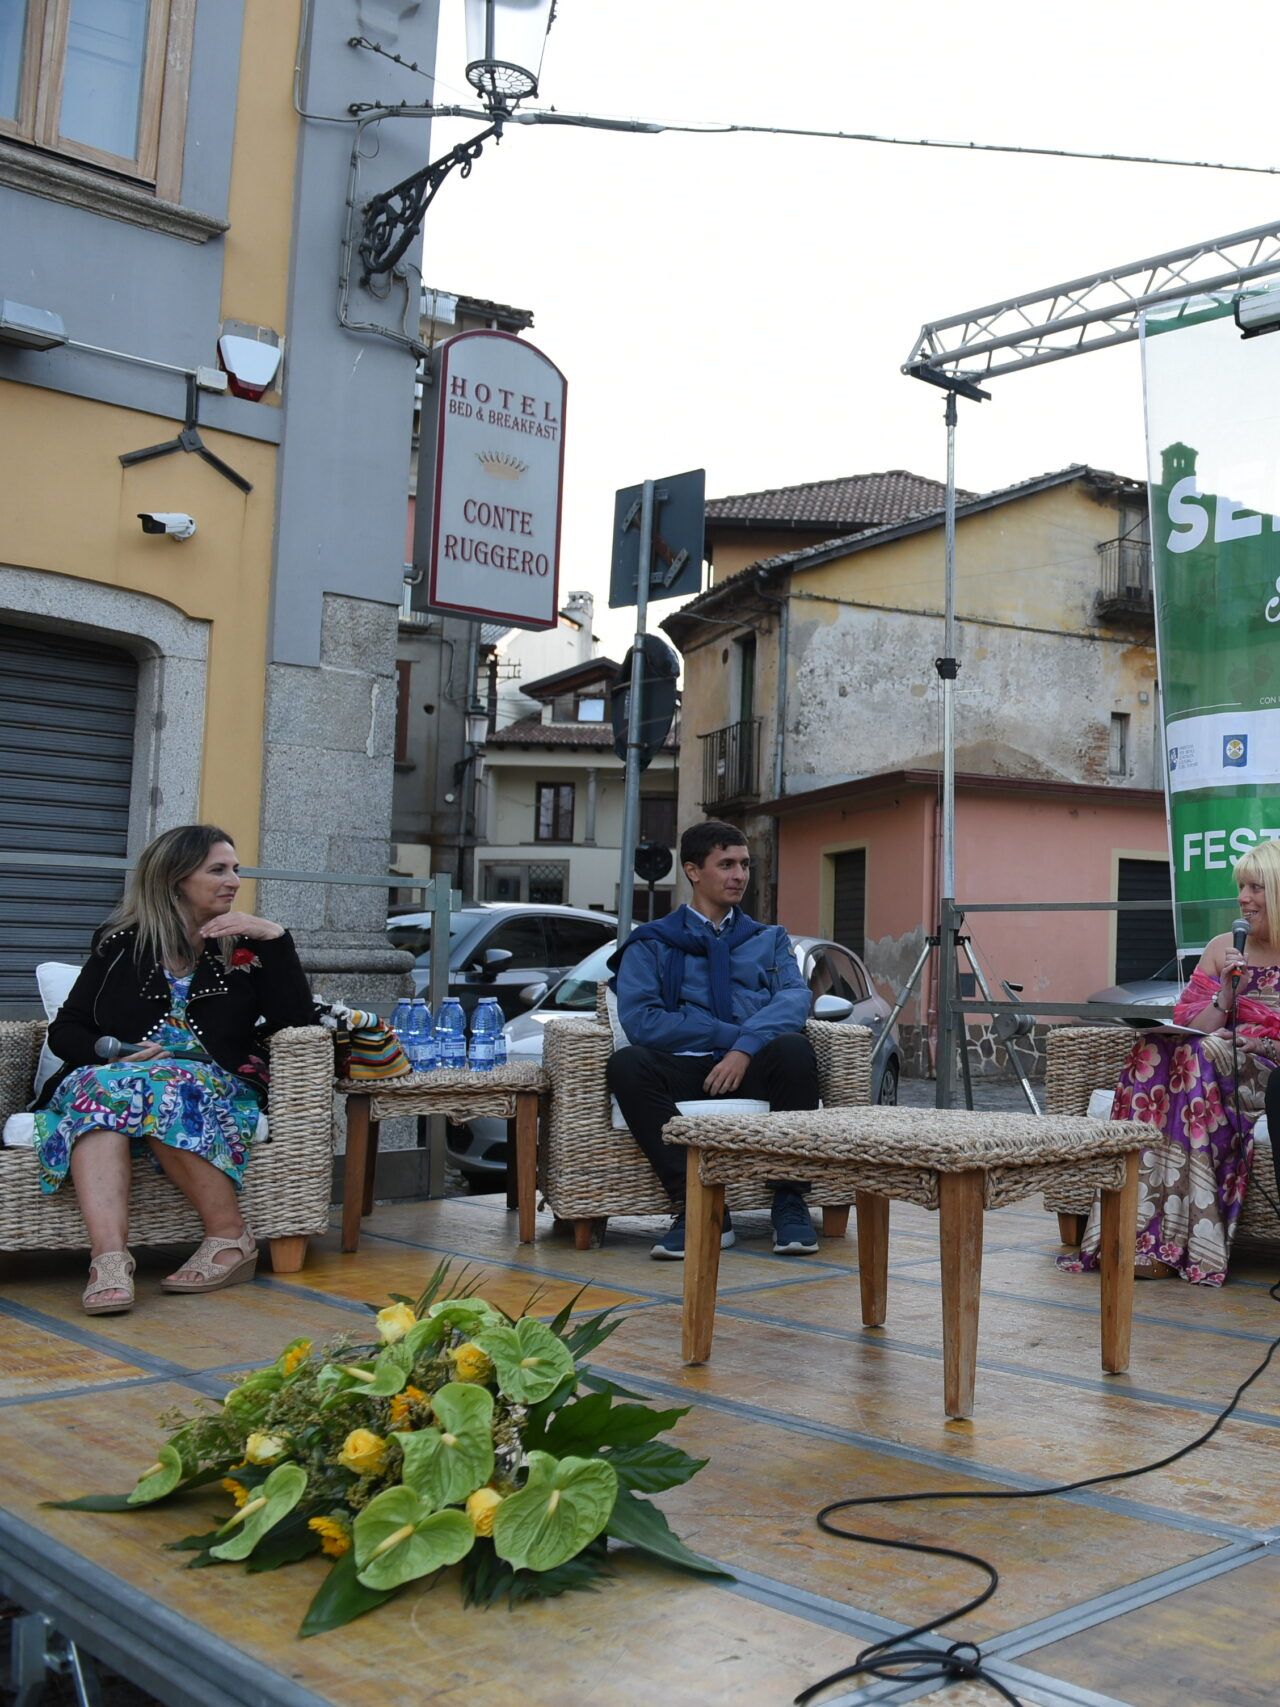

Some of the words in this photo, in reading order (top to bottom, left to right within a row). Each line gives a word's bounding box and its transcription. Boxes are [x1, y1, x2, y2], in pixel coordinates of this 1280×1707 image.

[449, 399, 473, 418] BED
[475, 406, 485, 422] &
[488, 409, 558, 441] BREAKFAST
[451, 375, 558, 423] HOTEL
[463, 498, 533, 536] CONTE
[444, 534, 549, 577] RUGGERO
[1260, 696, 1276, 705] CON
